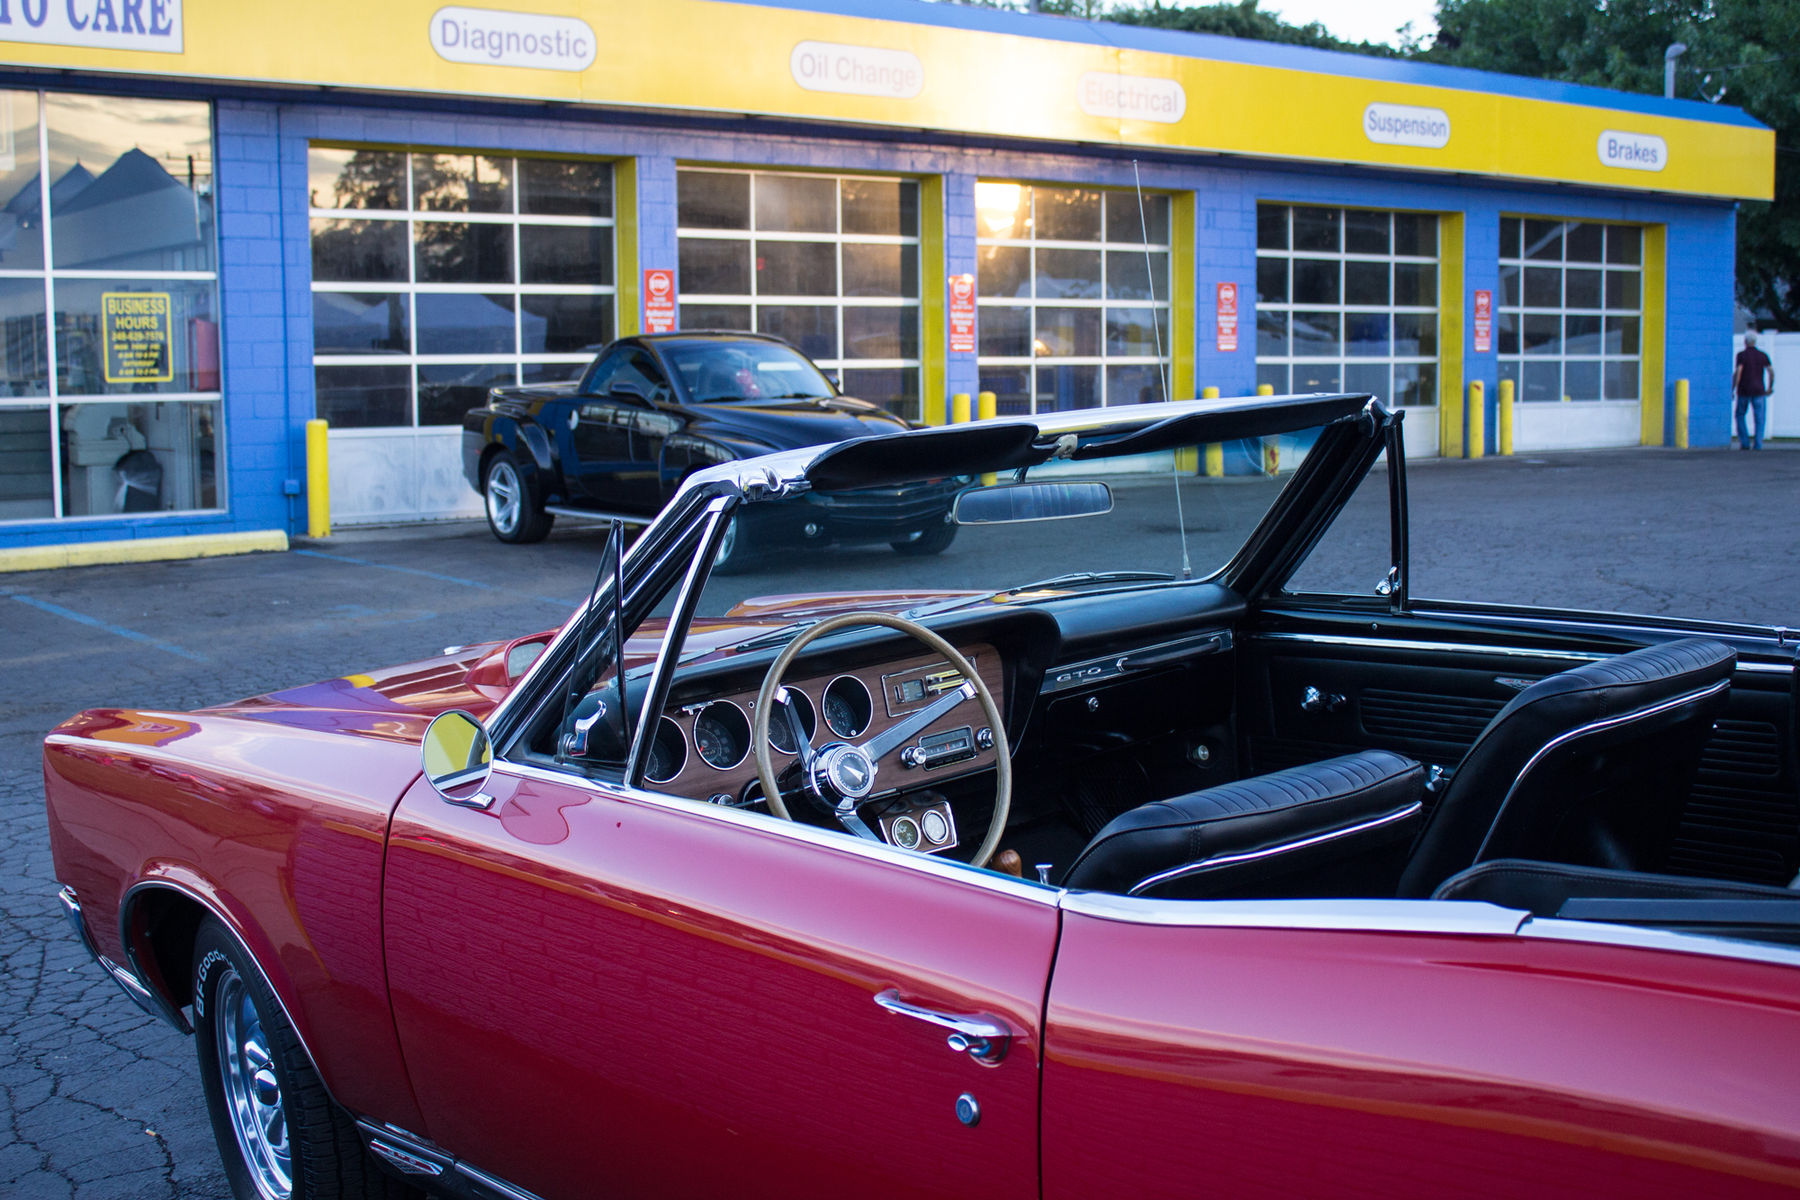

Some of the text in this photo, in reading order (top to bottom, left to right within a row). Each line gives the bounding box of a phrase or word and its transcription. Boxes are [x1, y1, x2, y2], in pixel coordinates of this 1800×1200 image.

[0, 0, 173, 36] O CARE
[441, 19, 588, 59] Diagnostic
[800, 53, 917, 92] Oil Change
[1085, 79, 1178, 113] Electrical
[1368, 109, 1448, 139] Suspension
[1608, 138, 1658, 163] Brakes
[108, 299, 165, 315] BUSINESS
[115, 316, 158, 330] HOURS
[1056, 666, 1102, 682] GTO
